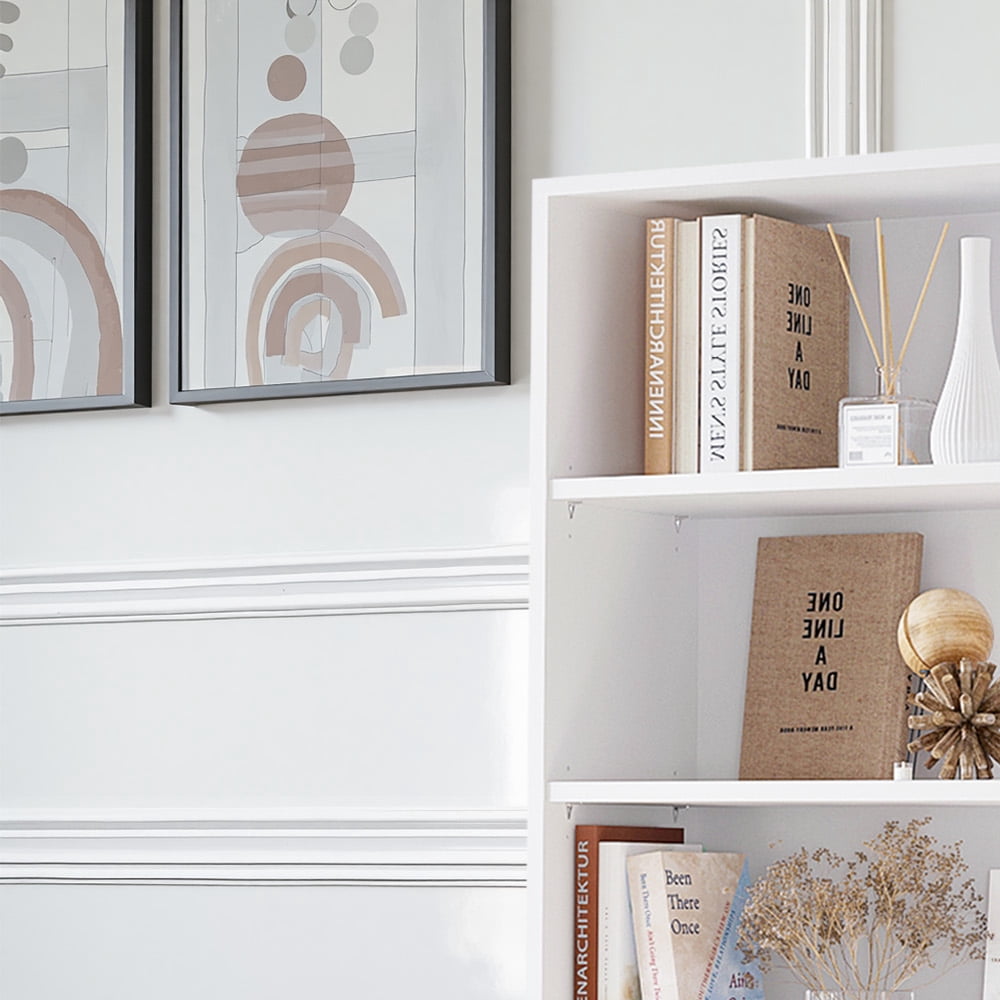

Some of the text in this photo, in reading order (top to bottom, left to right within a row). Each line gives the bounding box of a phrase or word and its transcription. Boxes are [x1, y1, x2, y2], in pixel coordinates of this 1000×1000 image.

[665, 869, 692, 886] Been
[667, 893, 700, 910] There
[670, 918, 700, 935] Once
